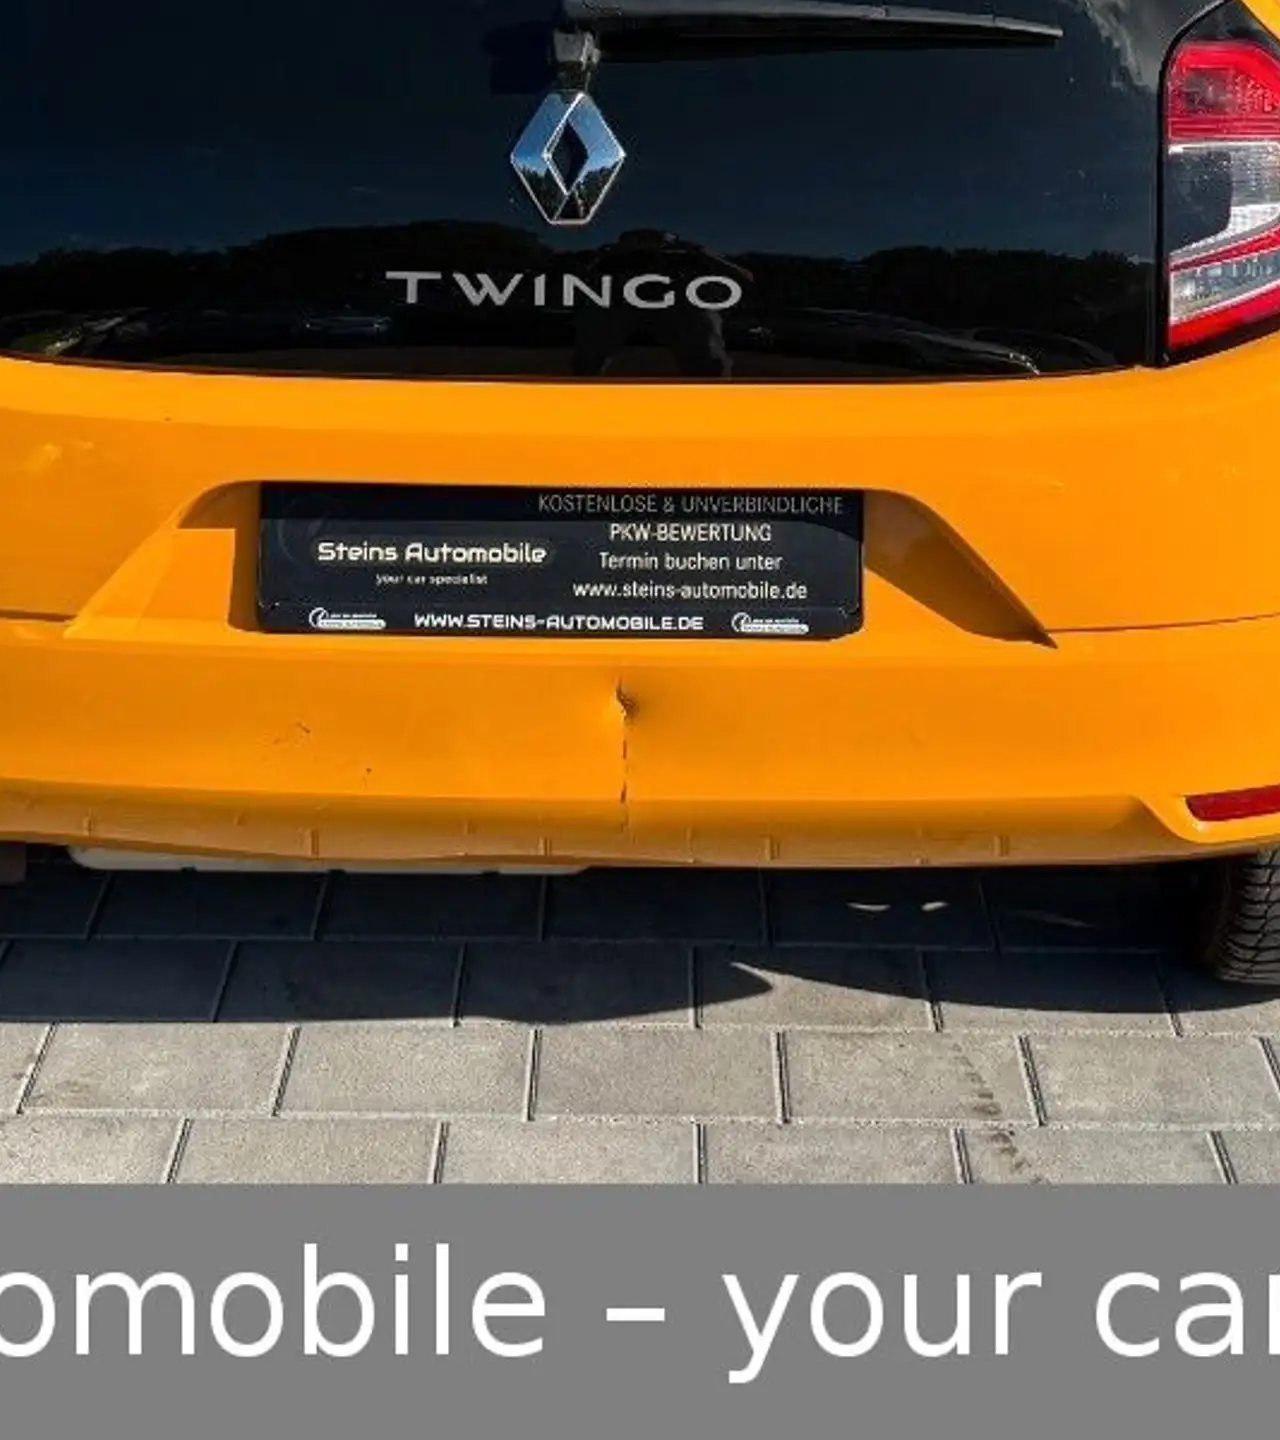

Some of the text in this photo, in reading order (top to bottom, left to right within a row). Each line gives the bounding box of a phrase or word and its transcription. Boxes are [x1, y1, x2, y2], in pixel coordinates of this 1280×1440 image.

[385, 270, 742, 310] TWINGO
[538, 494, 844, 515] KOSTENLOSE & UNVERBINDLICHE
[609, 523, 772, 542] PKW-BEWERTUNG
[318, 540, 548, 564] Steins Automobile
[599, 551, 783, 571] Termin buchen unter
[573, 579, 808, 599] www.steins-automobile.de
[413, 613, 705, 630] WWW.STEINS-AUTOMOBILE.DE
